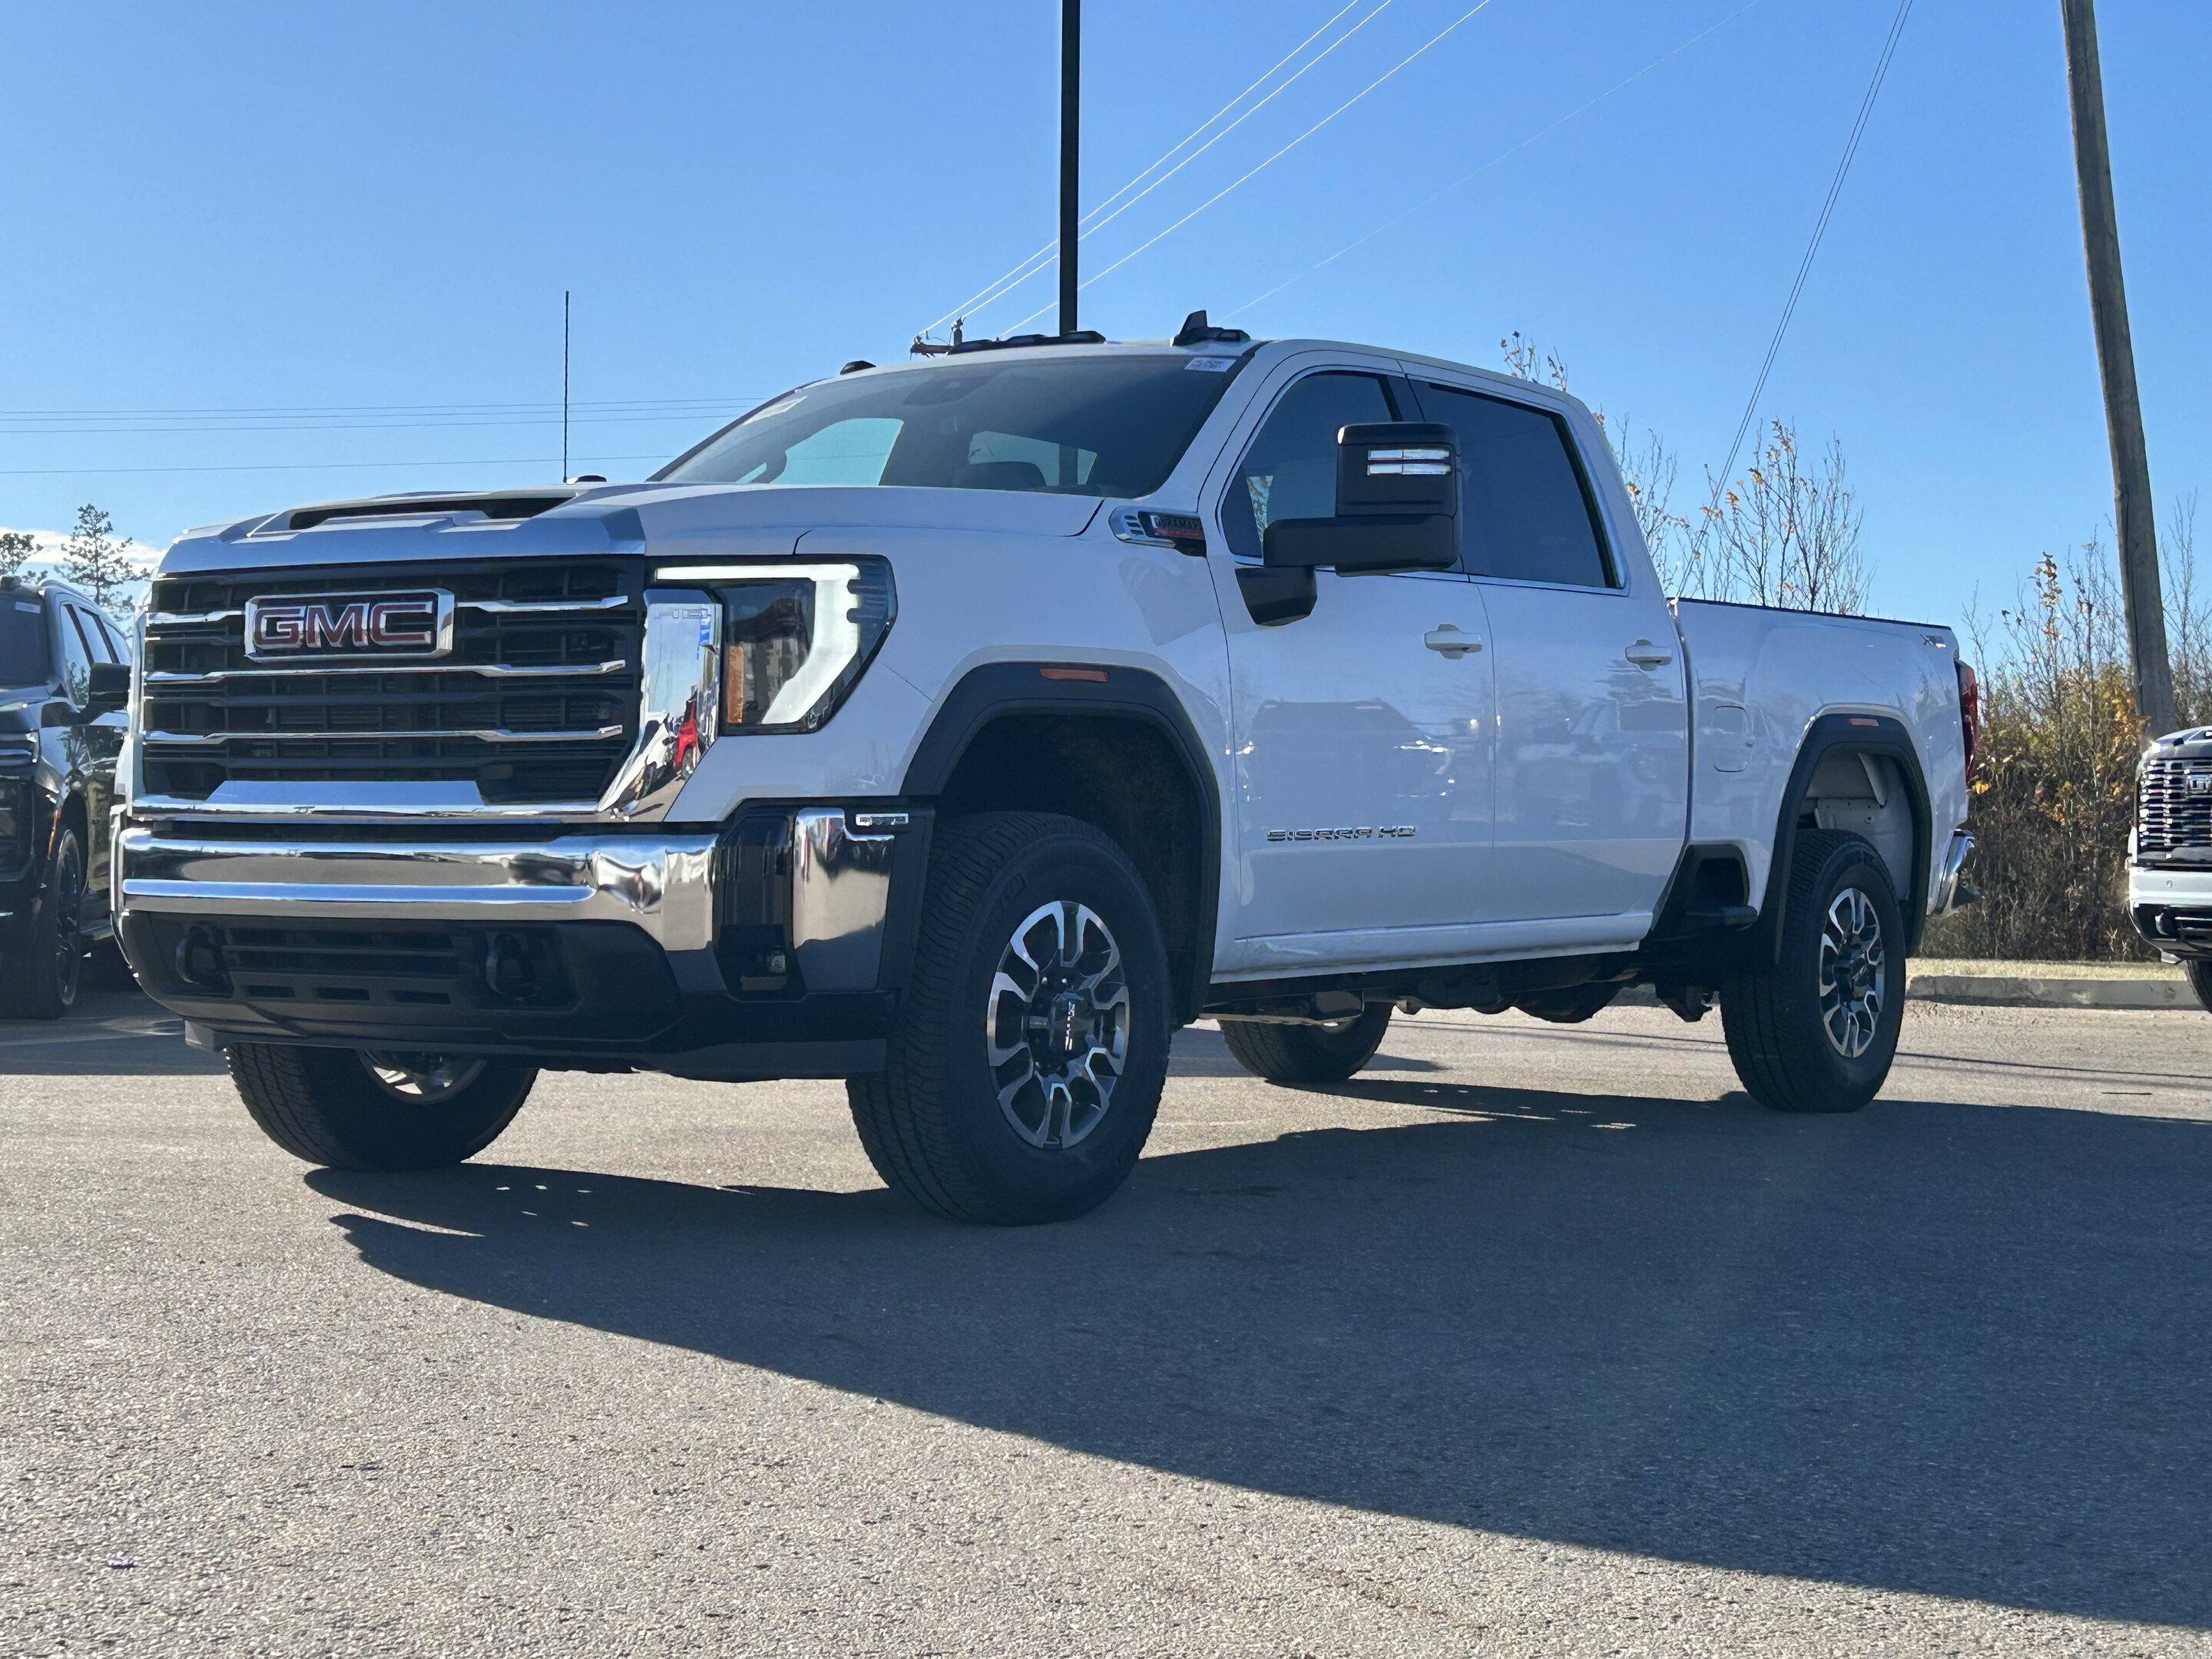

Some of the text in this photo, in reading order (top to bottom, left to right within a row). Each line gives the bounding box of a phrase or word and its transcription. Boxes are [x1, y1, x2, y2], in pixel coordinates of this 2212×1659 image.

[253, 601, 432, 650] GMC
[1267, 825, 1416, 842] SIERRA HD
